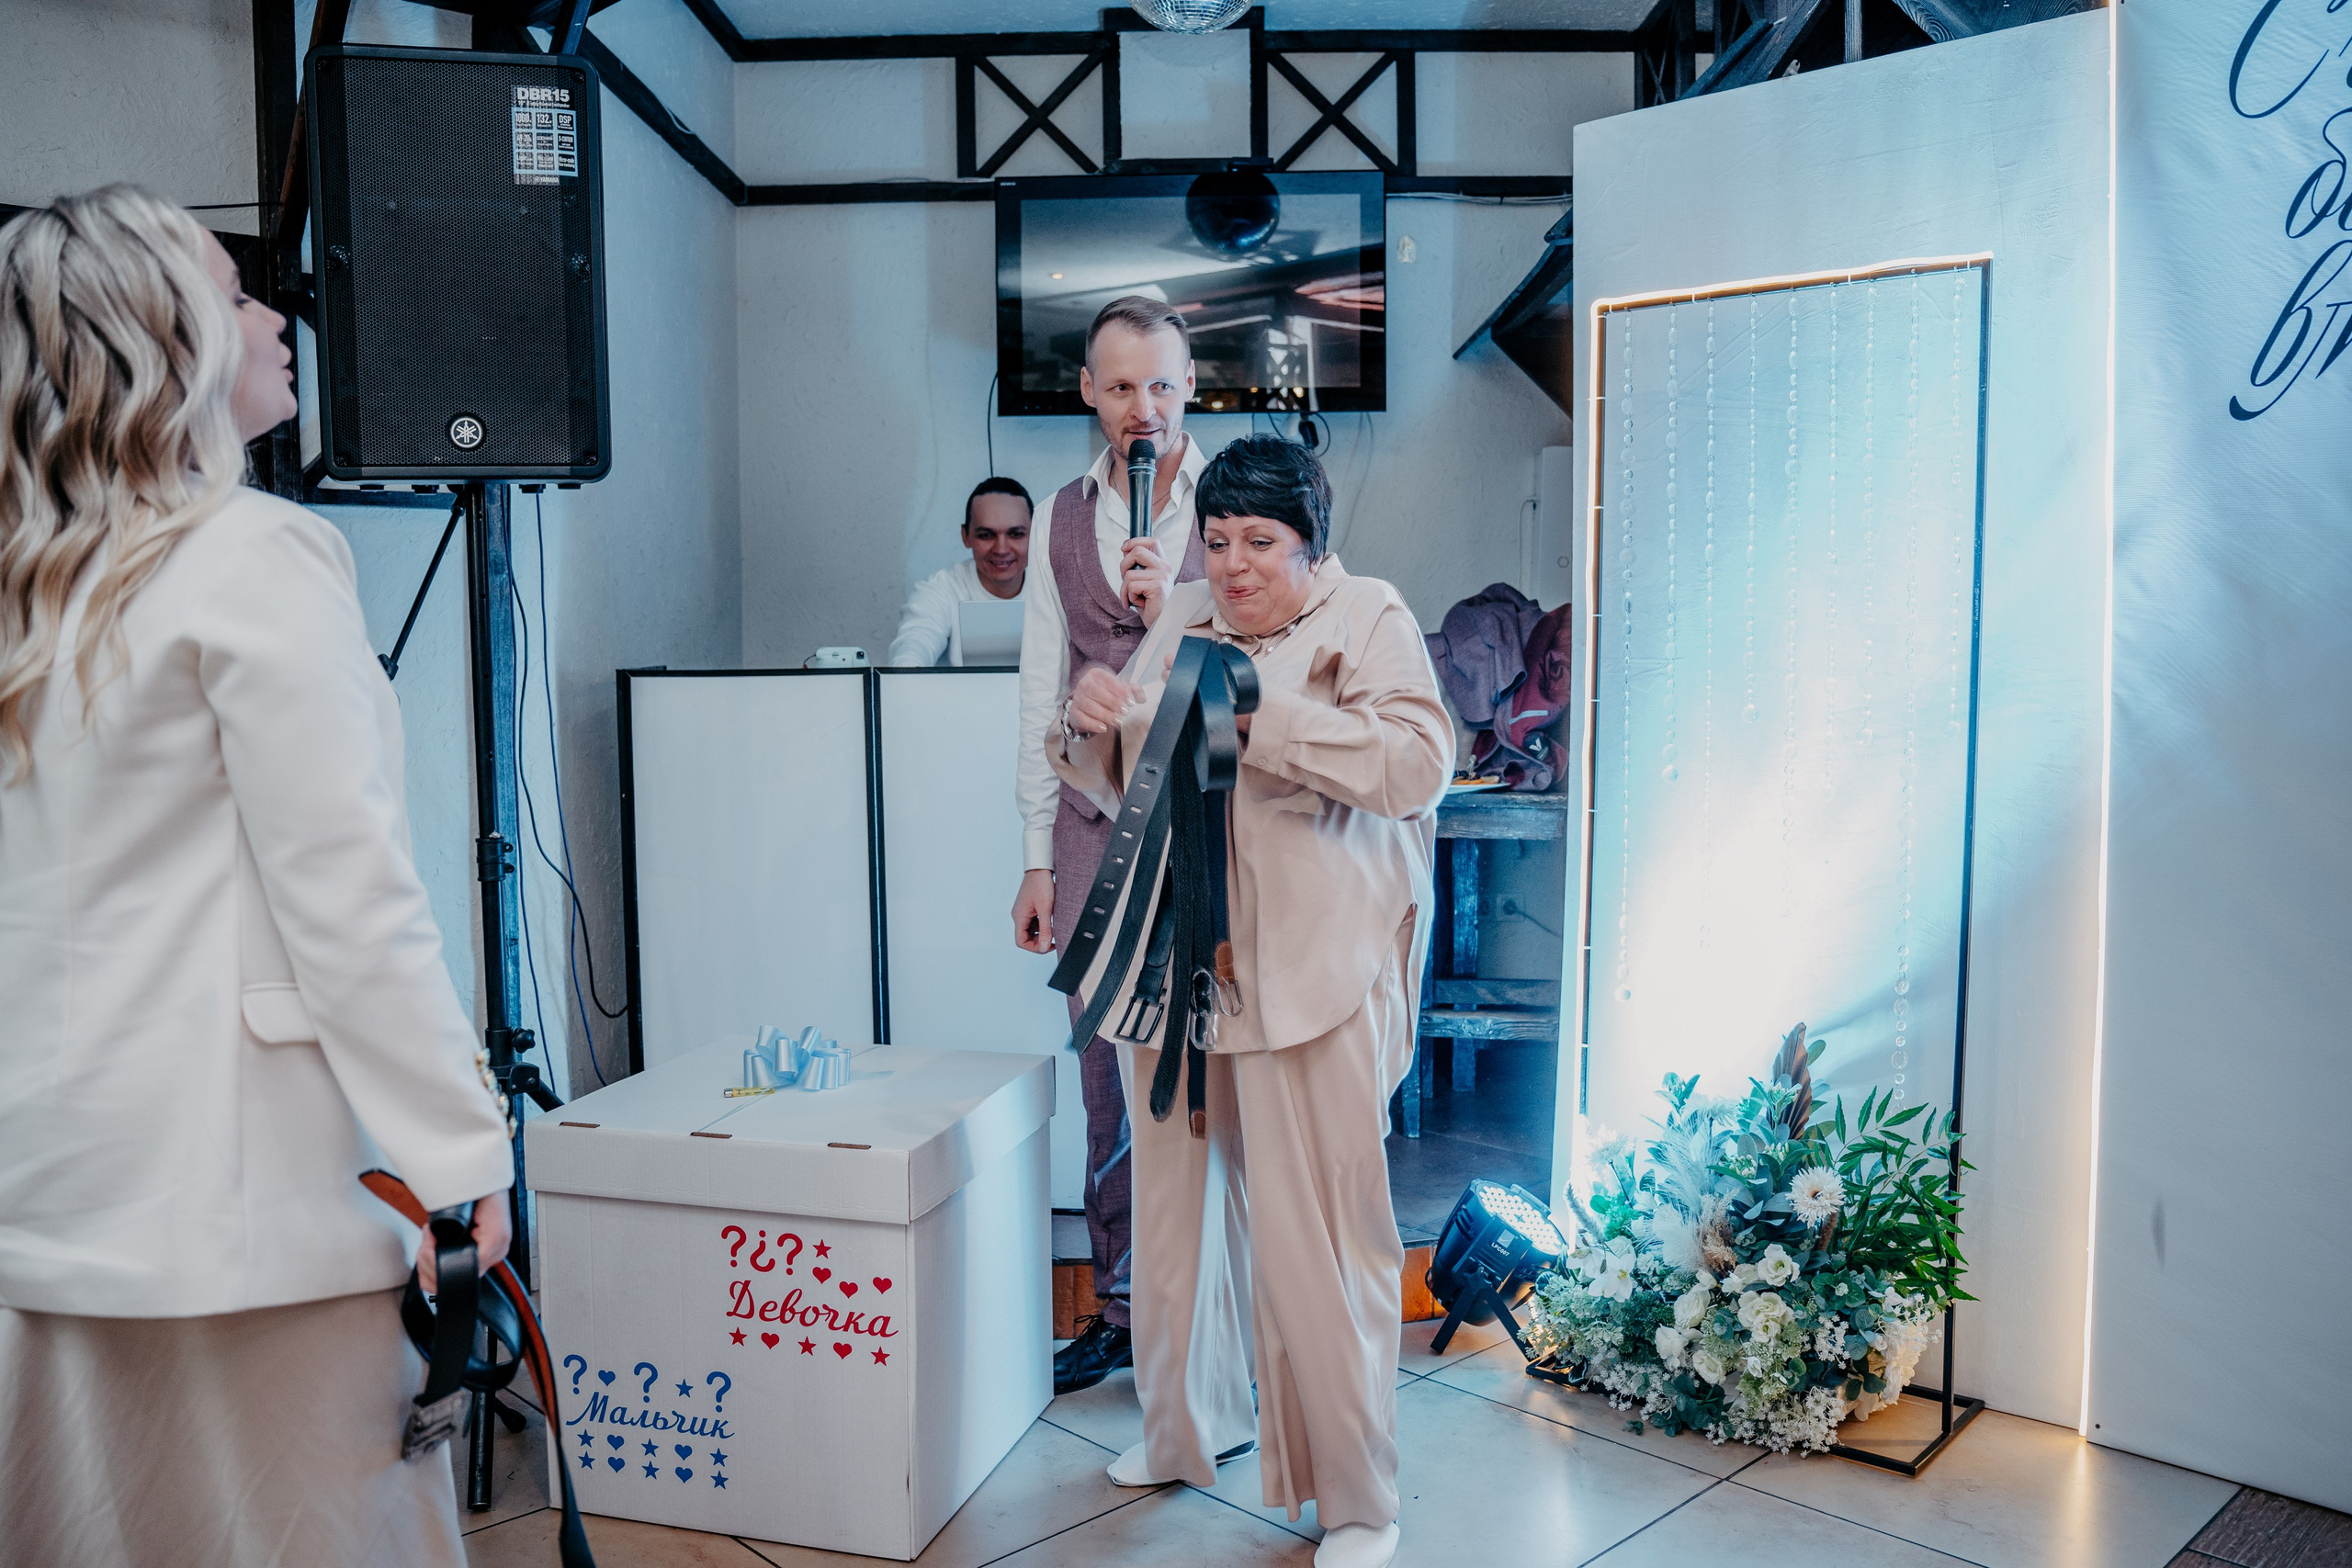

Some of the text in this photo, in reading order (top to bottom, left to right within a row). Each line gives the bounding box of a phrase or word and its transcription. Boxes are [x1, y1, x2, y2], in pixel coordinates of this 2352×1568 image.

[516, 87, 570, 102] DBR15
[559, 114, 571, 124] DSP
[726, 1280, 899, 1338] Девочка
[565, 1391, 734, 1439] Мальчик
